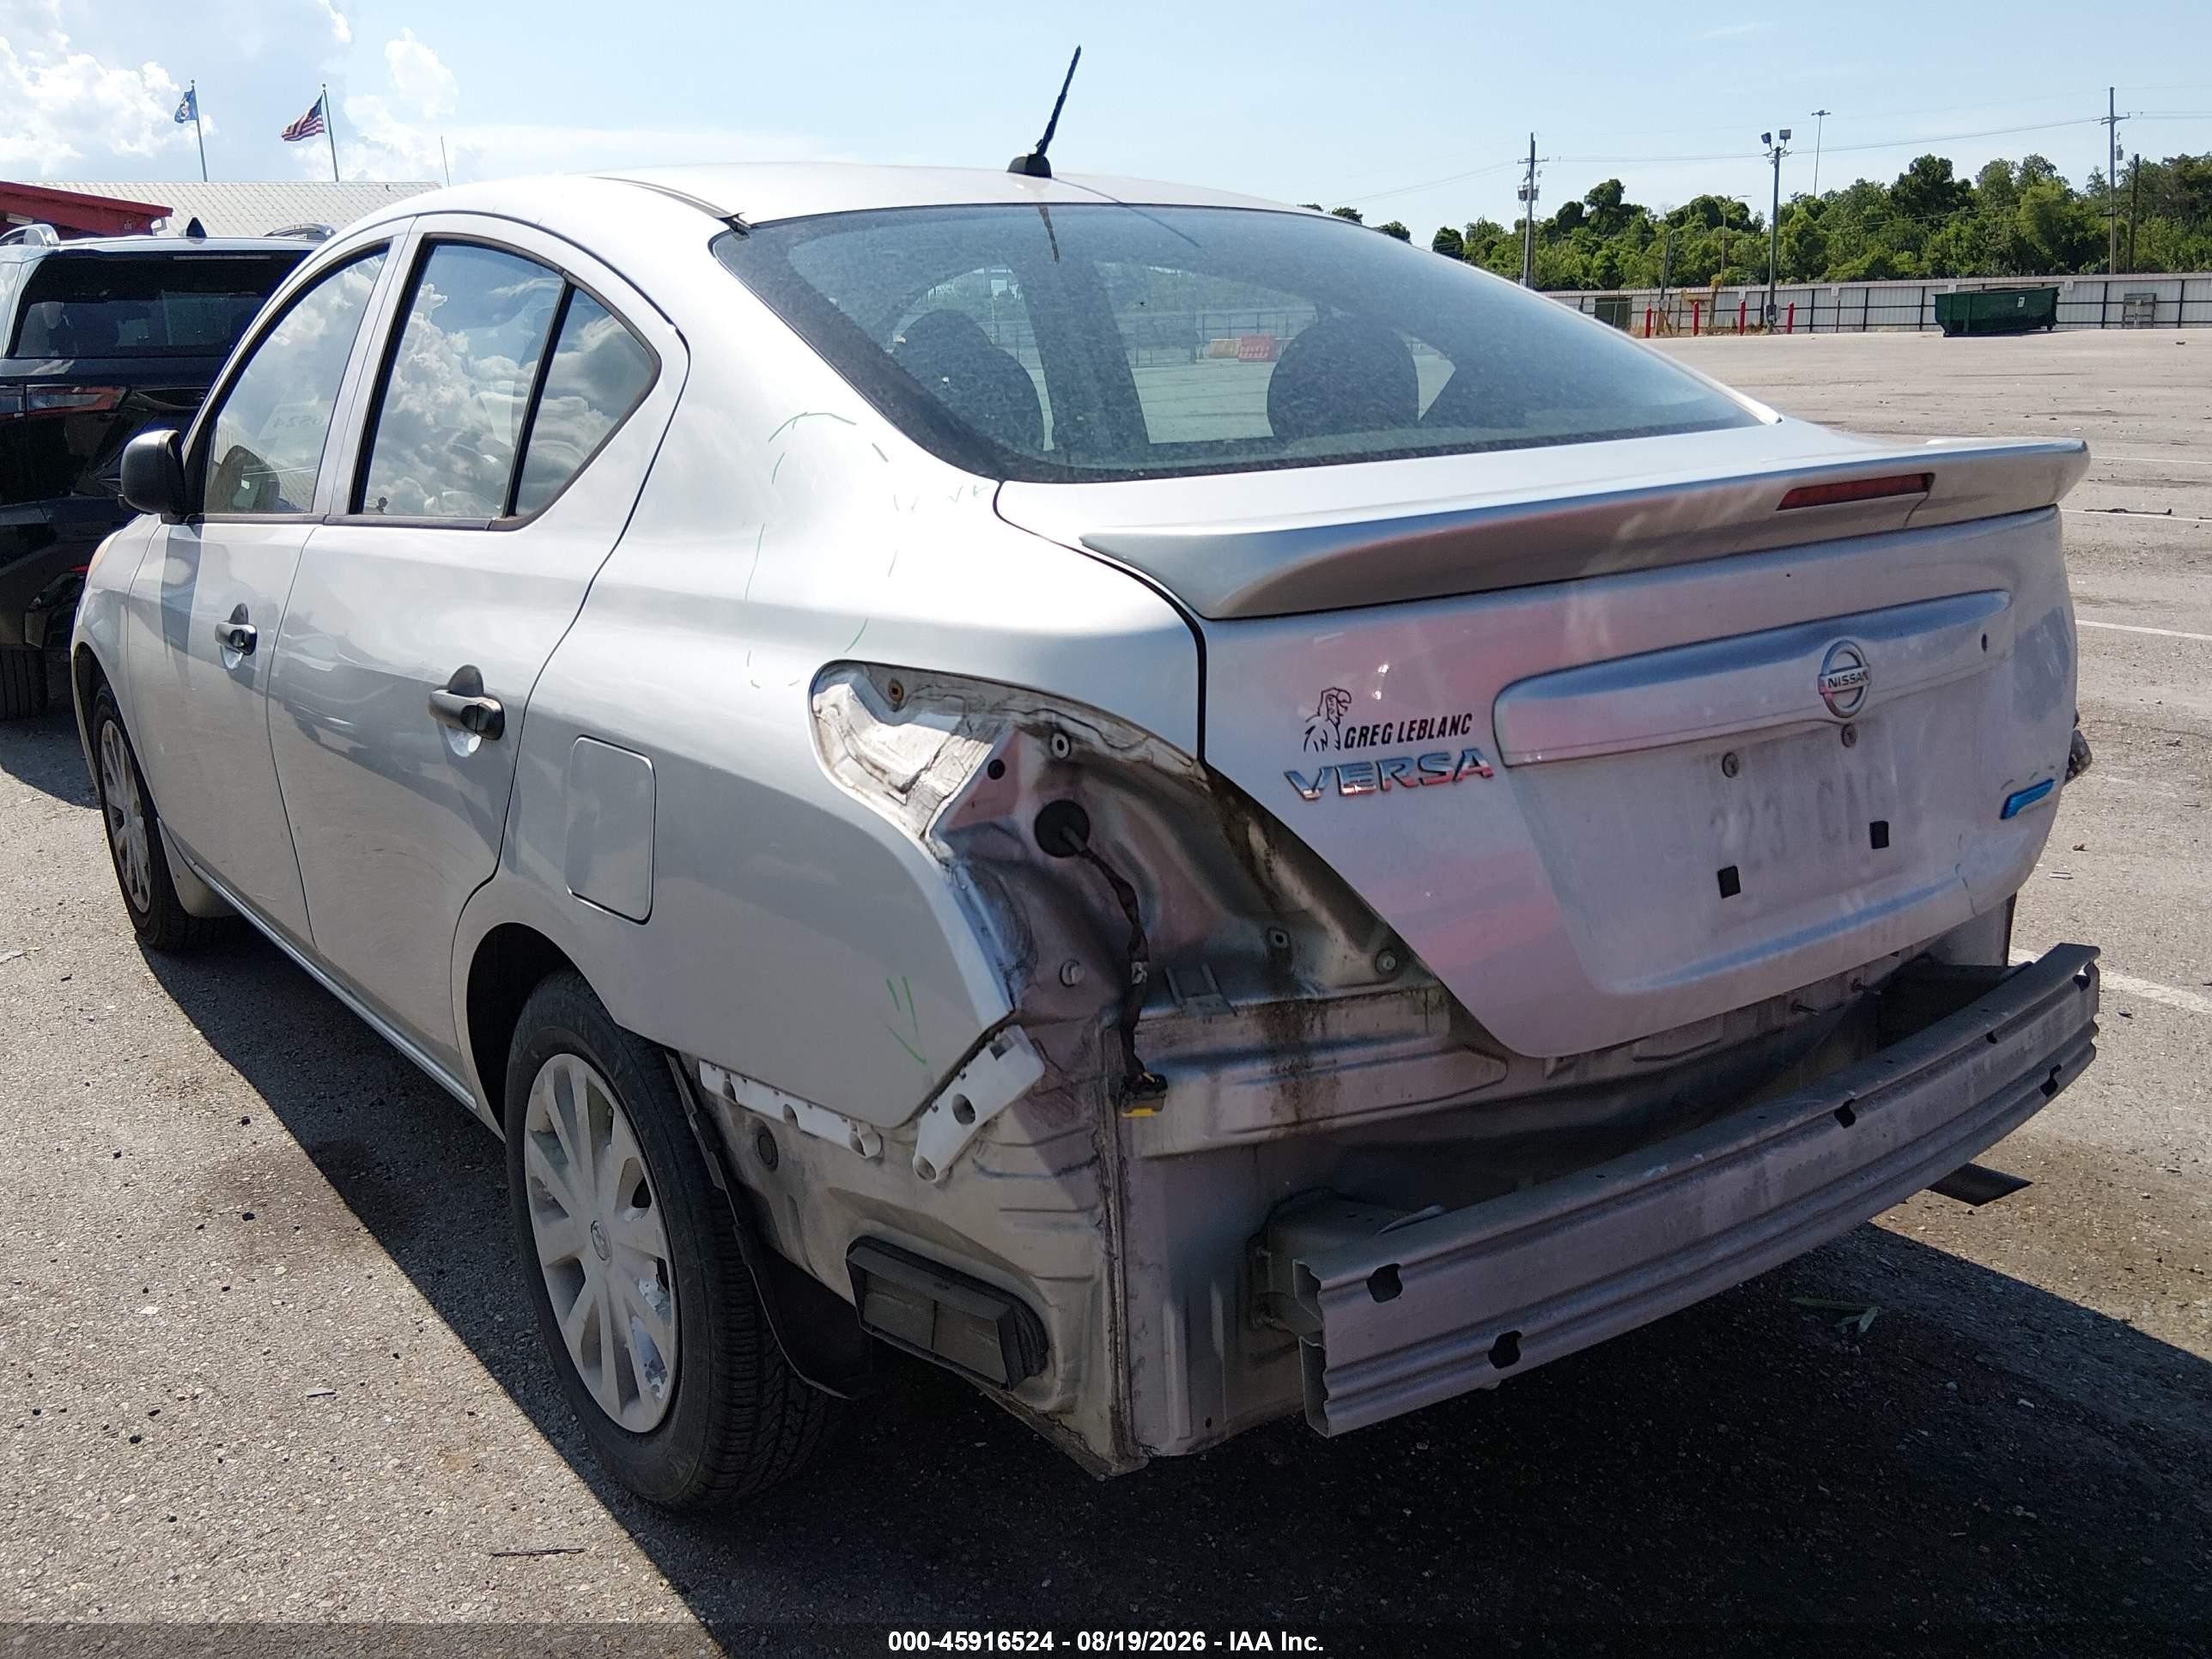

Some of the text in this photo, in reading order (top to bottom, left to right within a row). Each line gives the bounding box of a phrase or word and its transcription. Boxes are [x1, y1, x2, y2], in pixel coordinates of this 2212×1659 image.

[1827, 672, 1869, 688] NISSAN
[1345, 714, 1473, 748] GREG LEBLANC
[1284, 748, 1494, 800] VERSA
